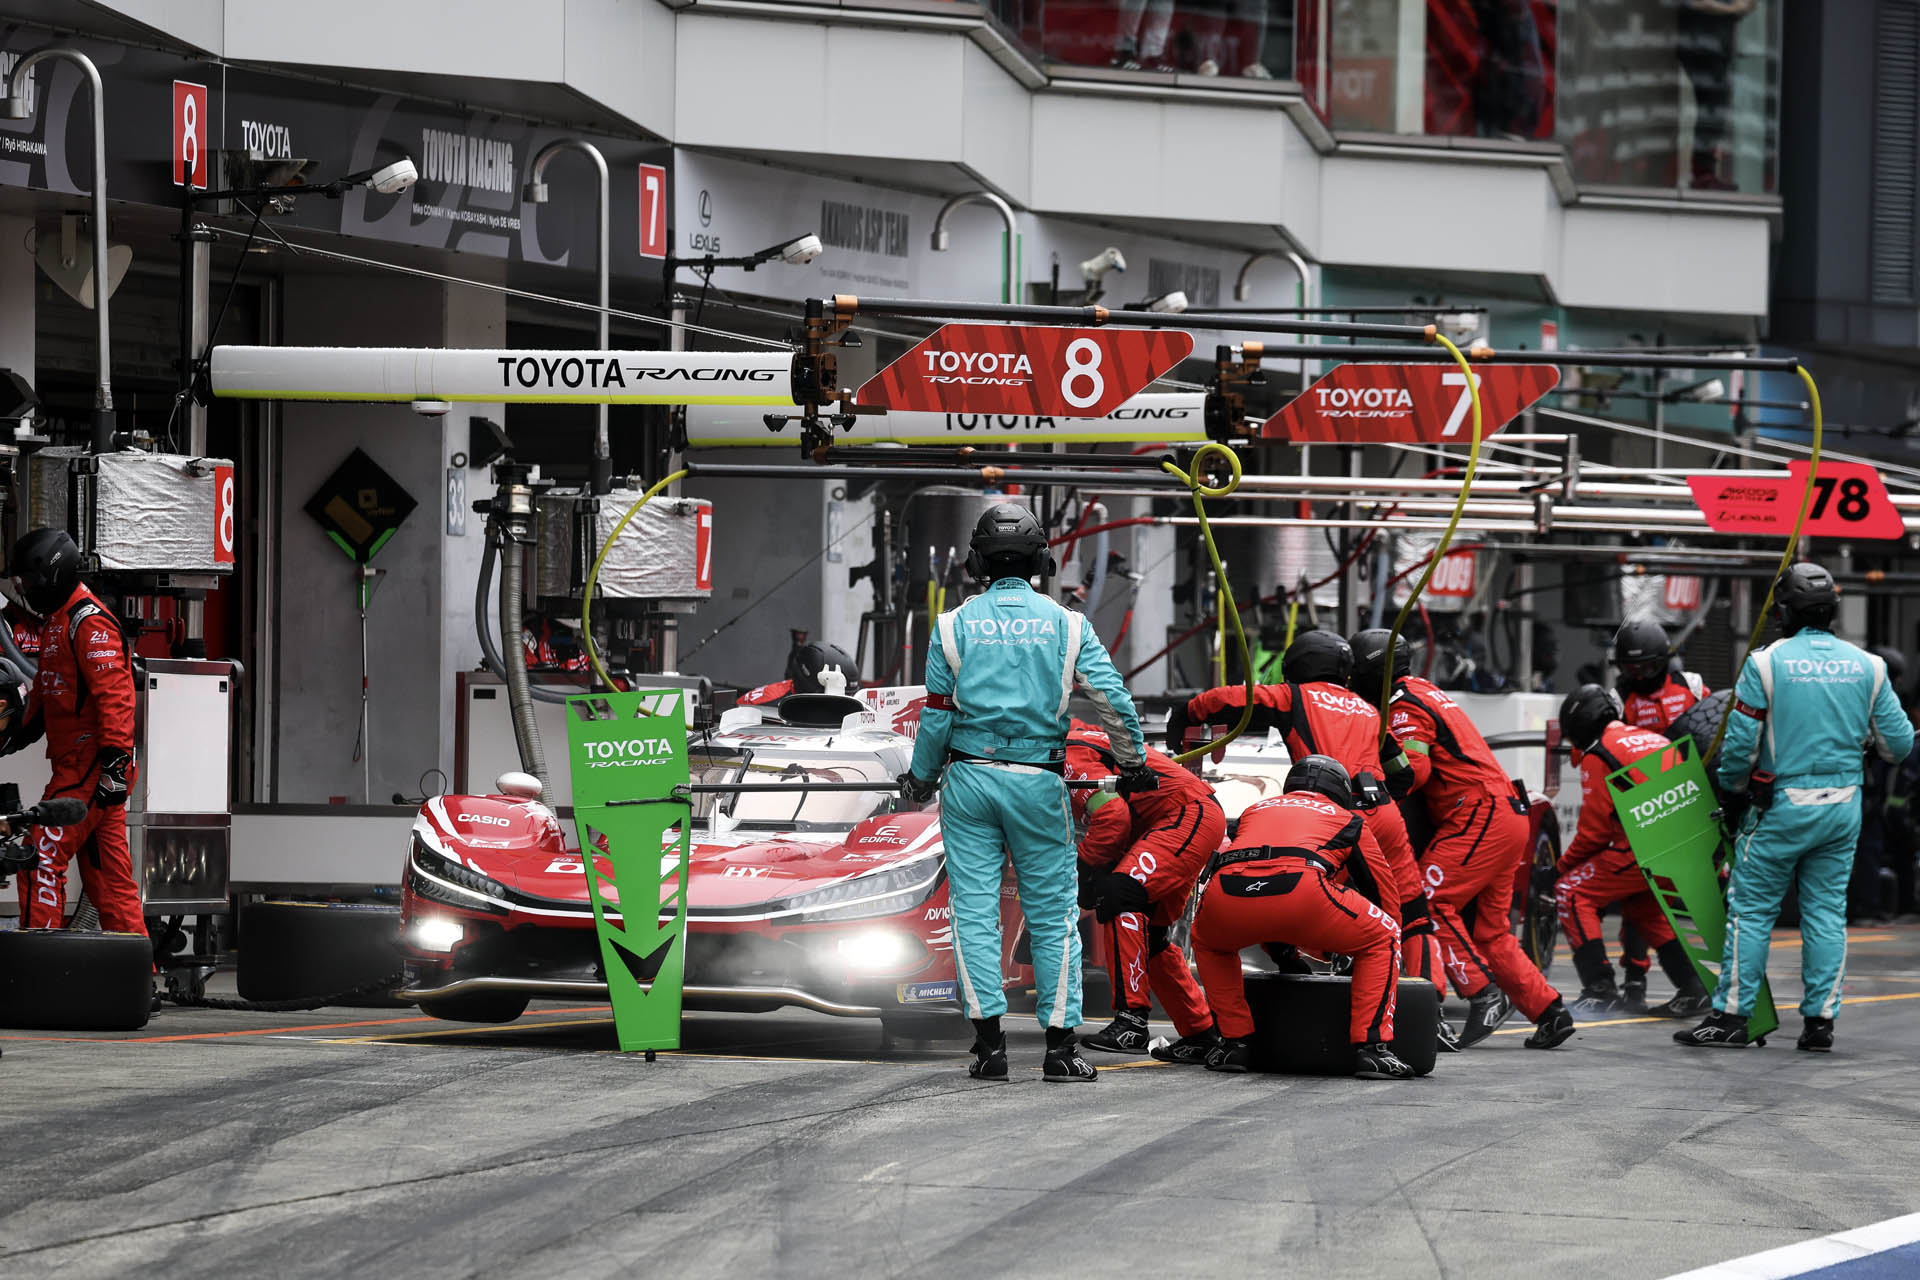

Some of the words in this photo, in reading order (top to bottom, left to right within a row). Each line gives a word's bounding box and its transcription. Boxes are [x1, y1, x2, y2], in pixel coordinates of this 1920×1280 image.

[182, 93, 198, 177] 8
[242, 120, 291, 158] TOYOTA
[17, 140, 48, 156] HIRAKAWA
[422, 127, 466, 185] TOYOTA
[468, 136, 513, 193] RACING
[646, 175, 659, 247] 7
[689, 232, 720, 253] LEXUS
[498, 357, 626, 388] TOYOTA
[626, 367, 788, 381] RACING
[923, 350, 1032, 375] TOYOTA
[1061, 337, 1104, 408] 8
[923, 375, 1032, 387] RACING
[1315, 388, 1413, 408] TOYOTA
[1441, 372, 1482, 437] 7
[1315, 410, 1413, 418] RACING
[449, 478, 465, 527] 33
[1808, 477, 1870, 522] 78
[220, 476, 234, 553] 8
[701, 513, 712, 581] 7
[965, 618, 1056, 636] TOYOTA
[95, 661, 117, 672] JFE
[1783, 659, 1865, 675] TOYOTA
[1307, 689, 1374, 713] TOYOTA
[584, 738, 673, 758] TOYOTA
[584, 757, 673, 768] RACING
[1255, 798, 1337, 815] TOYOTA
[1629, 779, 1699, 822] TOYOTA
[457, 813, 511, 827] CASIO
[859, 836, 909, 845] EDIFICE
[38, 825, 64, 907] DENSO
[724, 866, 769, 878] HY
[924, 906, 951, 920] ADVIC
[919, 986, 953, 996] MICHELIN
